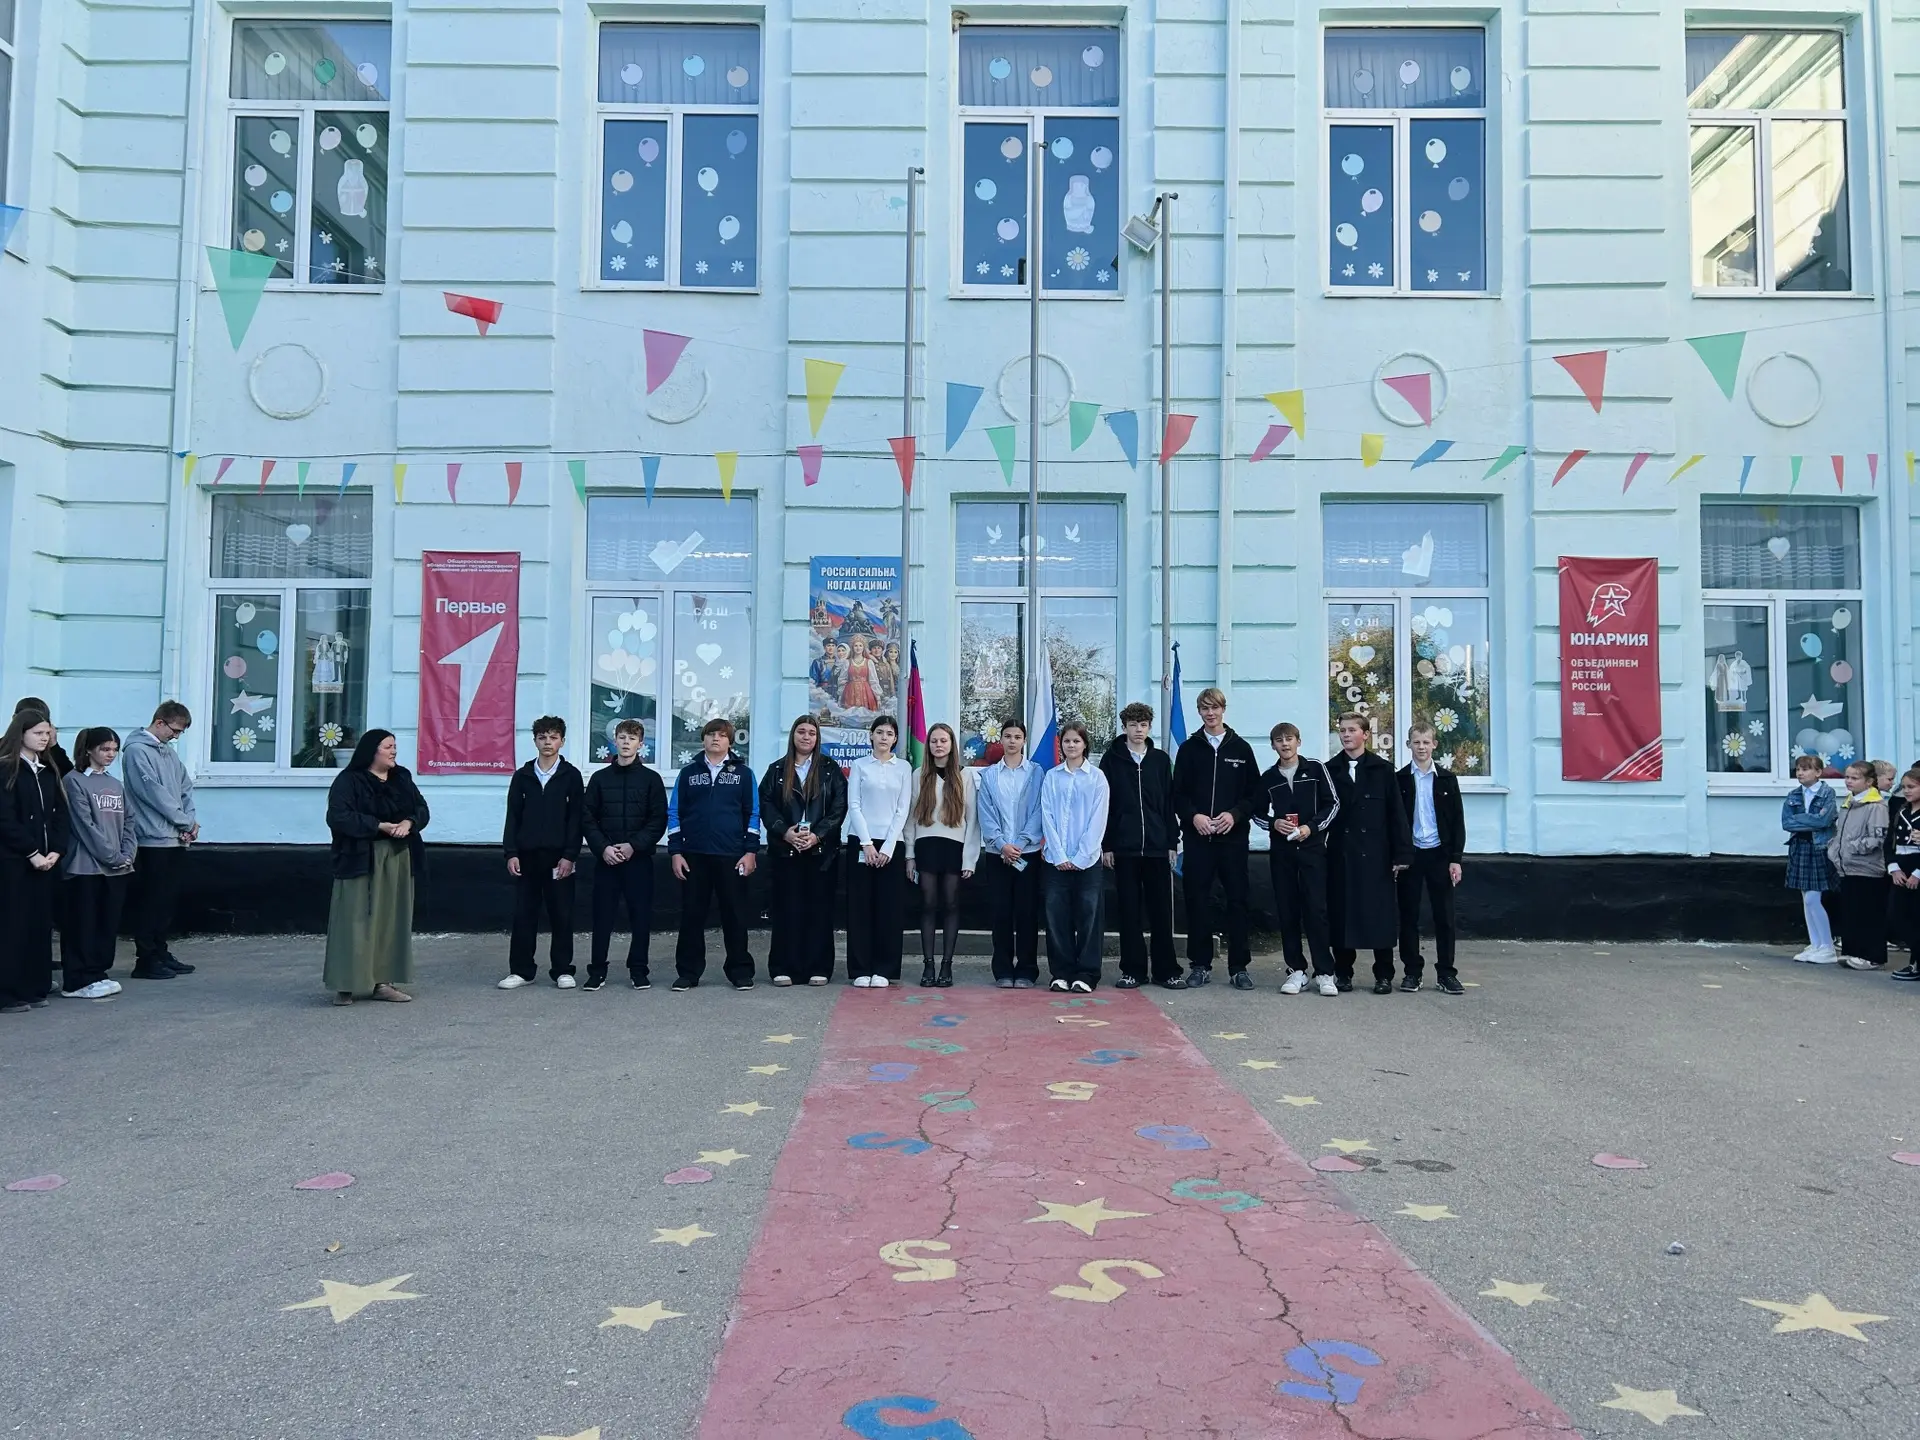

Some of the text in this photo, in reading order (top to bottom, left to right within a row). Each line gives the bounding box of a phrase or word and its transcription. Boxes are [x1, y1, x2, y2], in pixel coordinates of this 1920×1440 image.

[820, 566, 897, 578] РОССИЯ СИЛЬНА,
[827, 580, 891, 592] КОГДА ЕДИНА!
[435, 597, 507, 618] Первые
[701, 619, 718, 630] 16
[1570, 632, 1649, 646] ЮНАРМИЯ
[1570, 658, 1639, 669] ОБЪЕДИНЯЕМ
[1570, 669, 1604, 680] ДЕТЕЙ
[1571, 682, 1612, 691] РОССИИ
[829, 748, 846, 757] ГОД
[92, 793, 122, 810] Village
